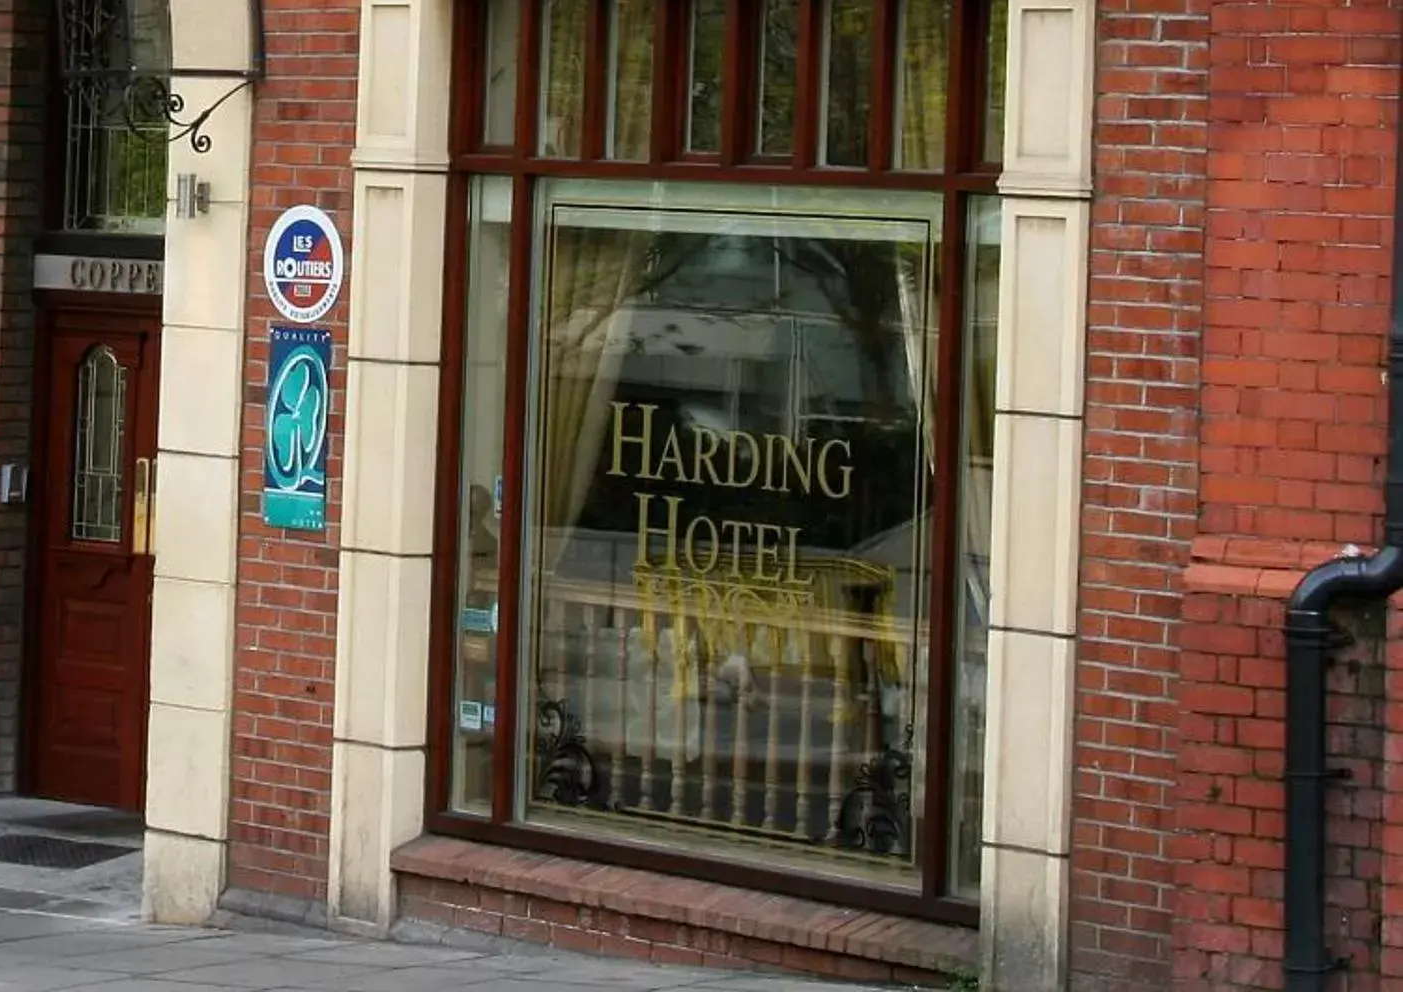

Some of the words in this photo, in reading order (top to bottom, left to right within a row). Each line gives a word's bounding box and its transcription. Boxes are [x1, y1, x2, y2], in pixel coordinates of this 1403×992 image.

[276, 256, 332, 279] ROUTIERS
[606, 401, 855, 499] HARDING
[633, 492, 814, 586] HOTEL
